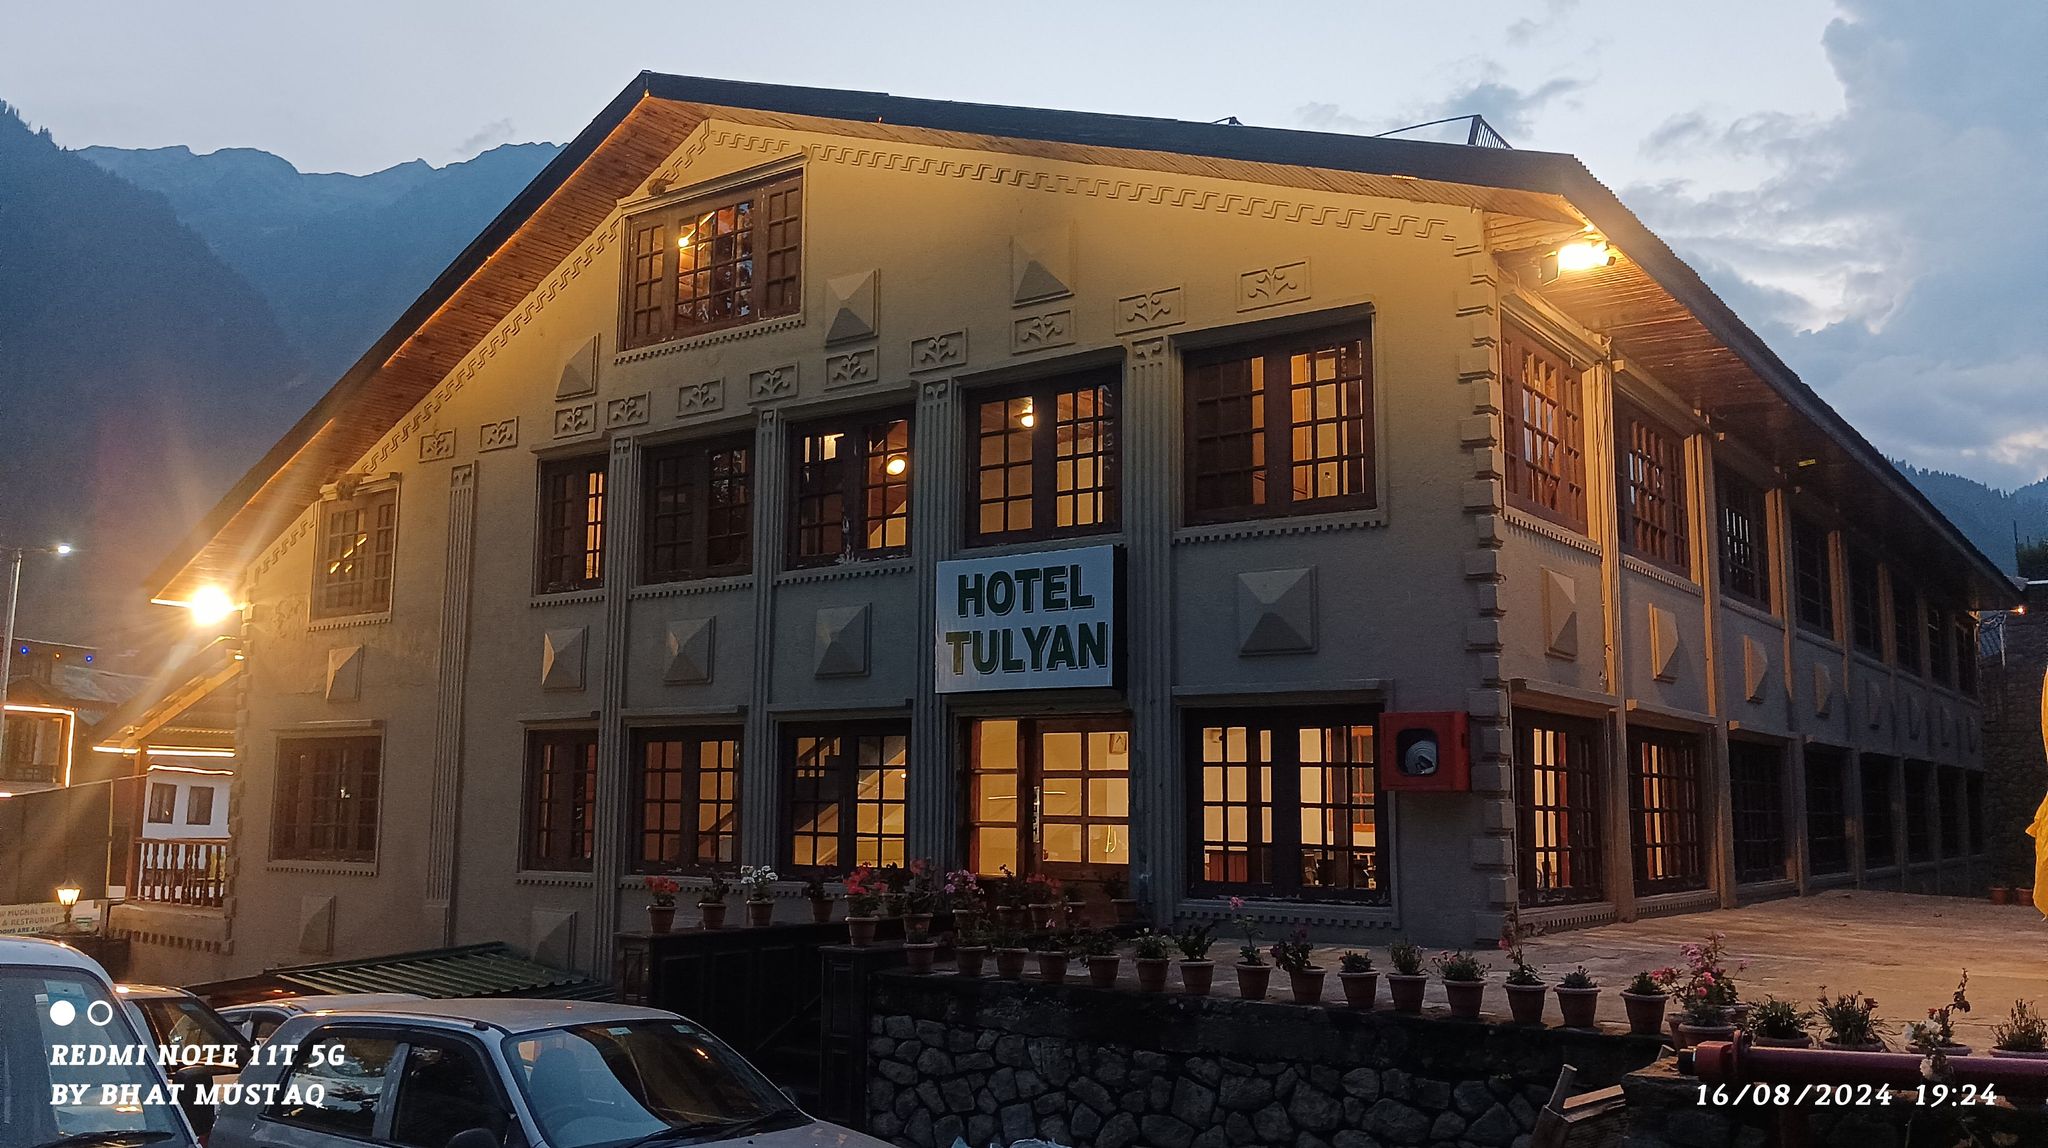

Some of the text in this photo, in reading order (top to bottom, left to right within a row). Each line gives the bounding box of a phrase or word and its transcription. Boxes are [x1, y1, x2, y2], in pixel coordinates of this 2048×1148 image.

[957, 564, 1095, 618] HOTEL
[945, 621, 1109, 675] TULYAN
[11, 916, 58, 926] RESTAURANT
